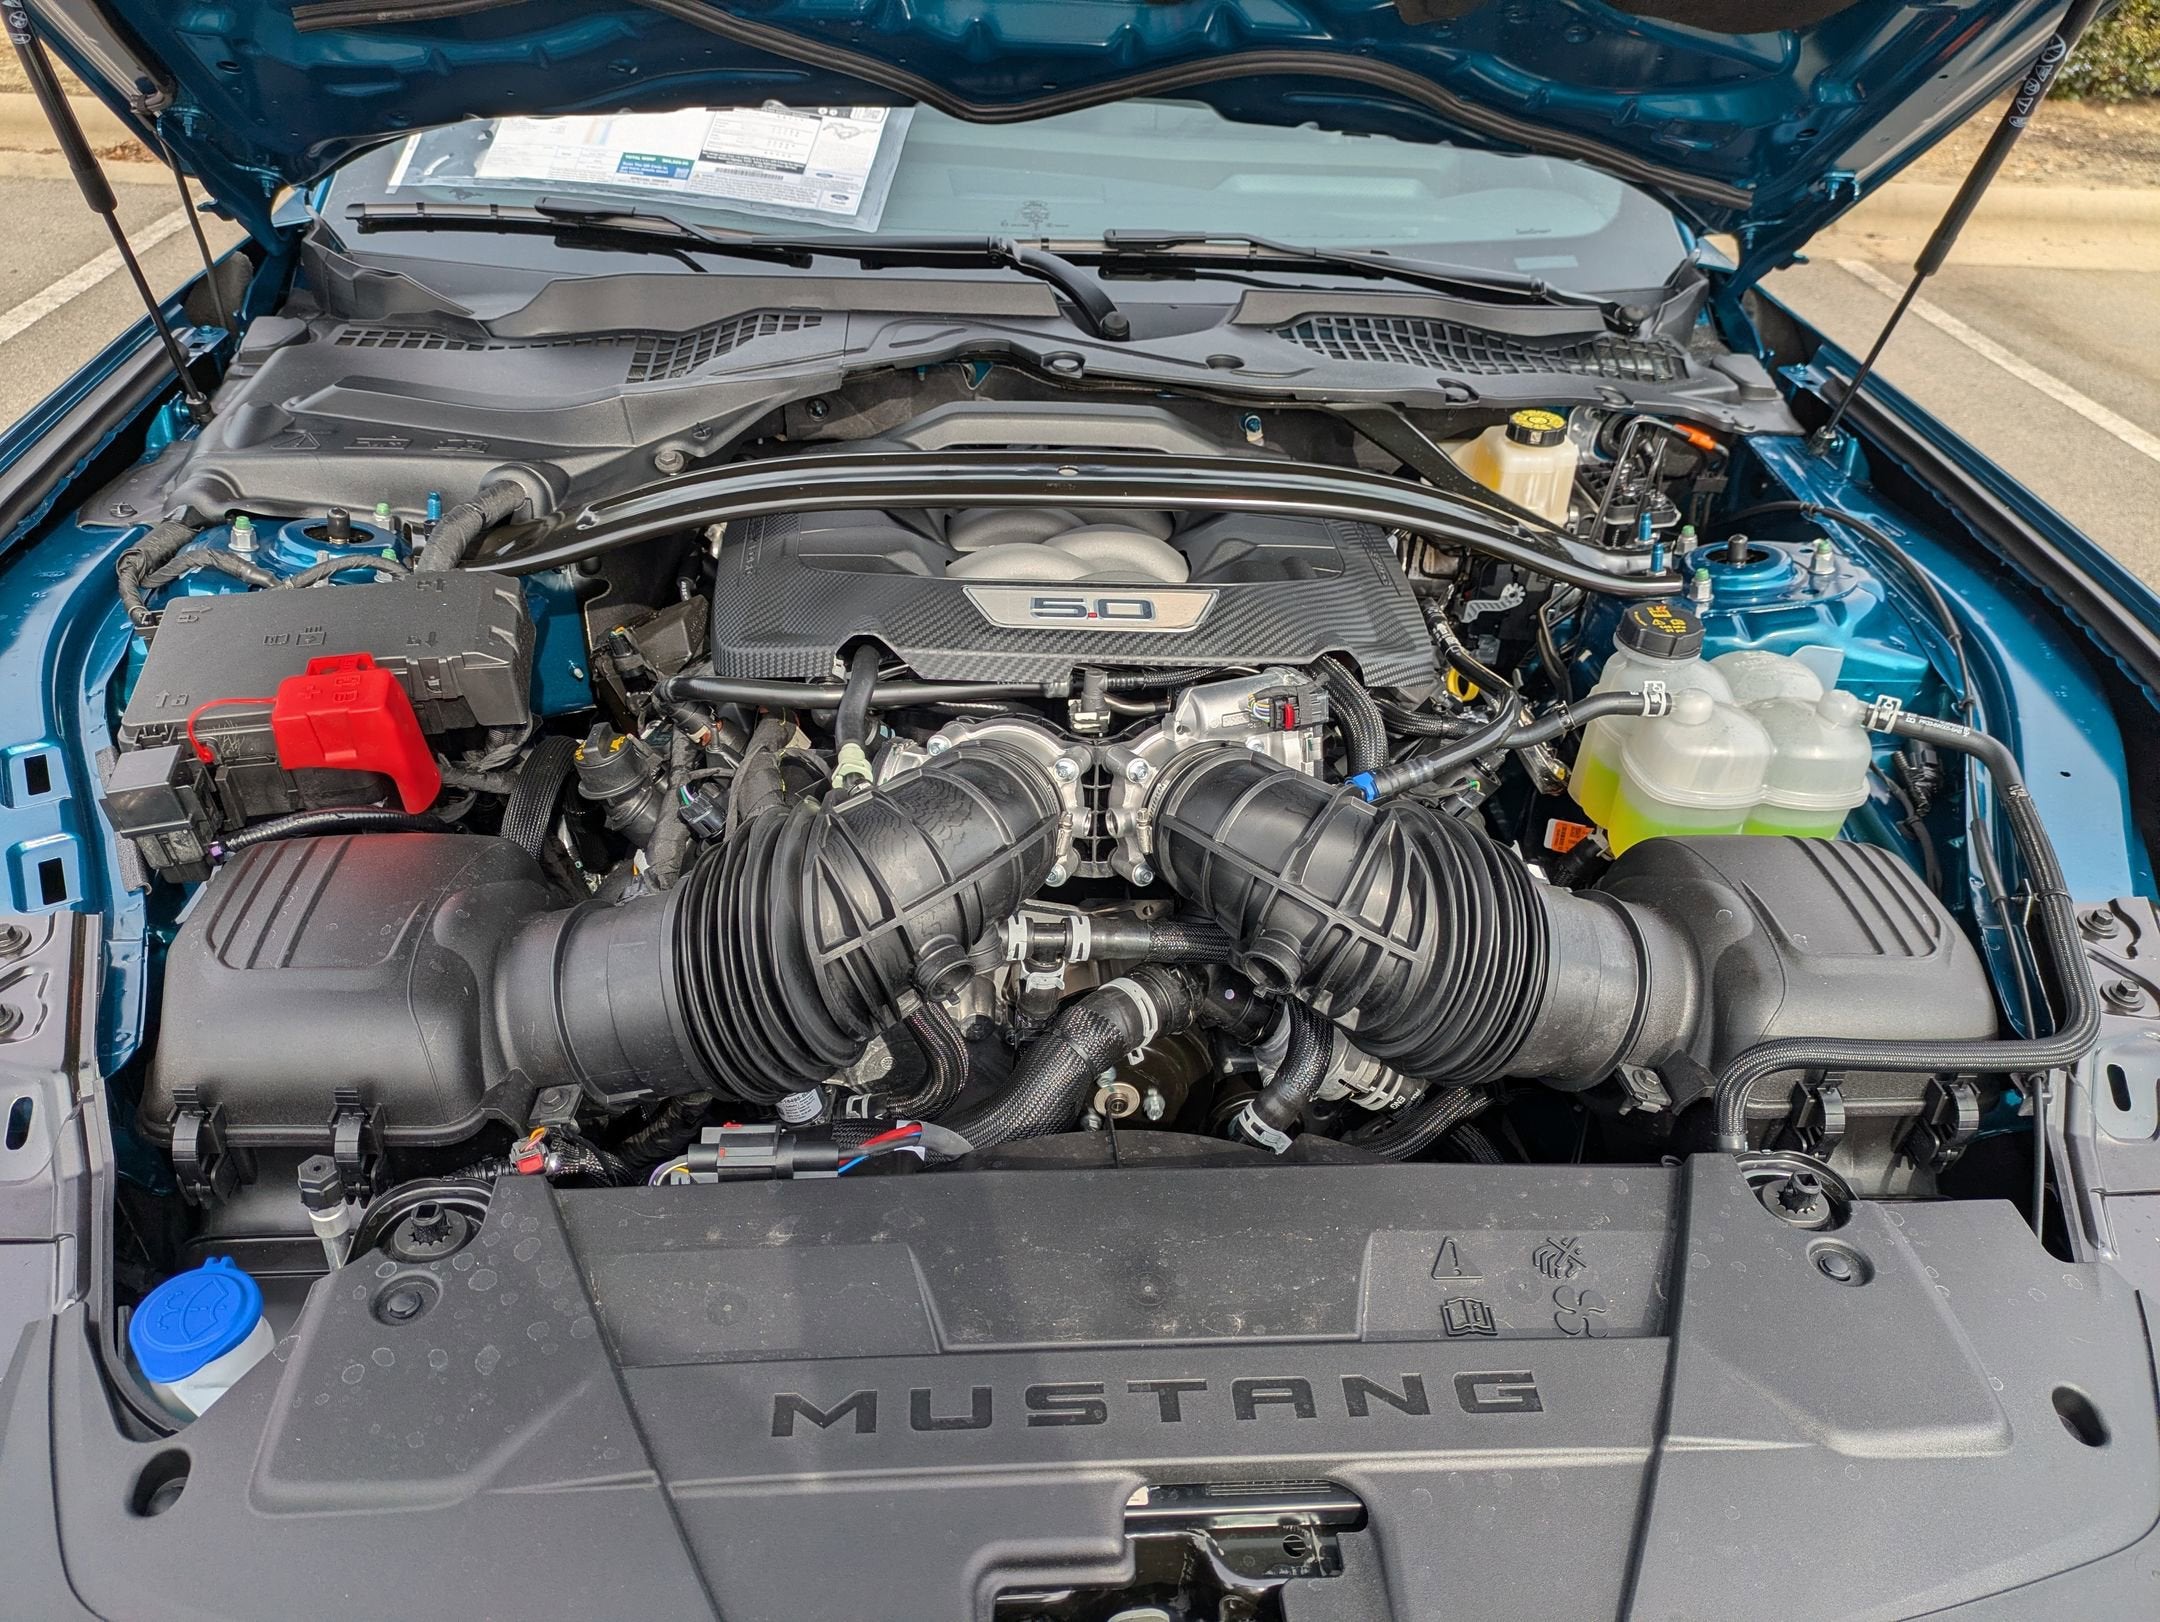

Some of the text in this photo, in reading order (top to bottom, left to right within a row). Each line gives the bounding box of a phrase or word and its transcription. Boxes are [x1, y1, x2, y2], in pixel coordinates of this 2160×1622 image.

[1030, 597, 1156, 619] 5.0
[1389, 1095, 1406, 1110] ENG
[771, 1370, 1545, 1437] MUSTANG
